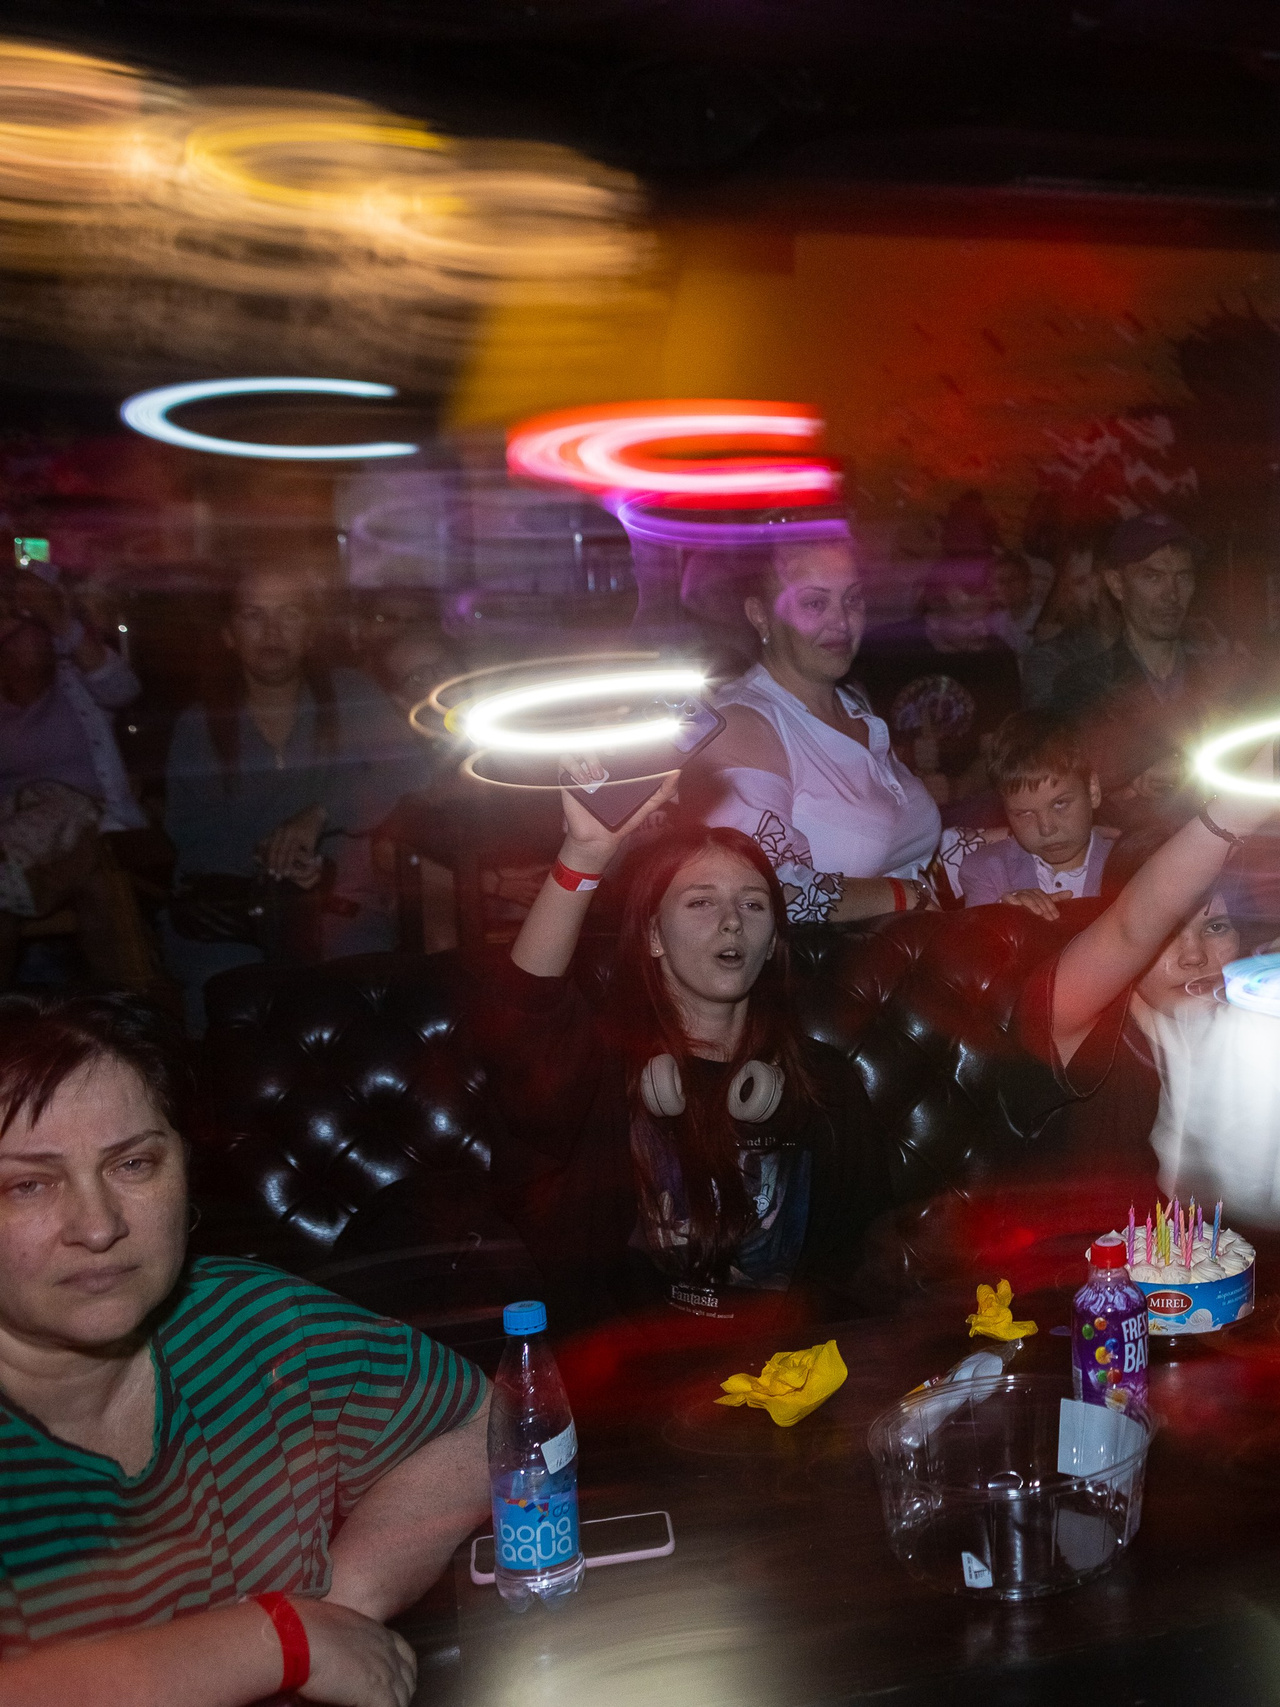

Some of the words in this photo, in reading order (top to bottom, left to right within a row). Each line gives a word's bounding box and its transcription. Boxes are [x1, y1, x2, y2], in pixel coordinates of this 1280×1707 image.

[671, 1285, 718, 1308] Fantasia
[1150, 1296, 1187, 1309] MIREL
[500, 1516, 571, 1543] bona
[502, 1535, 572, 1566] aqua
